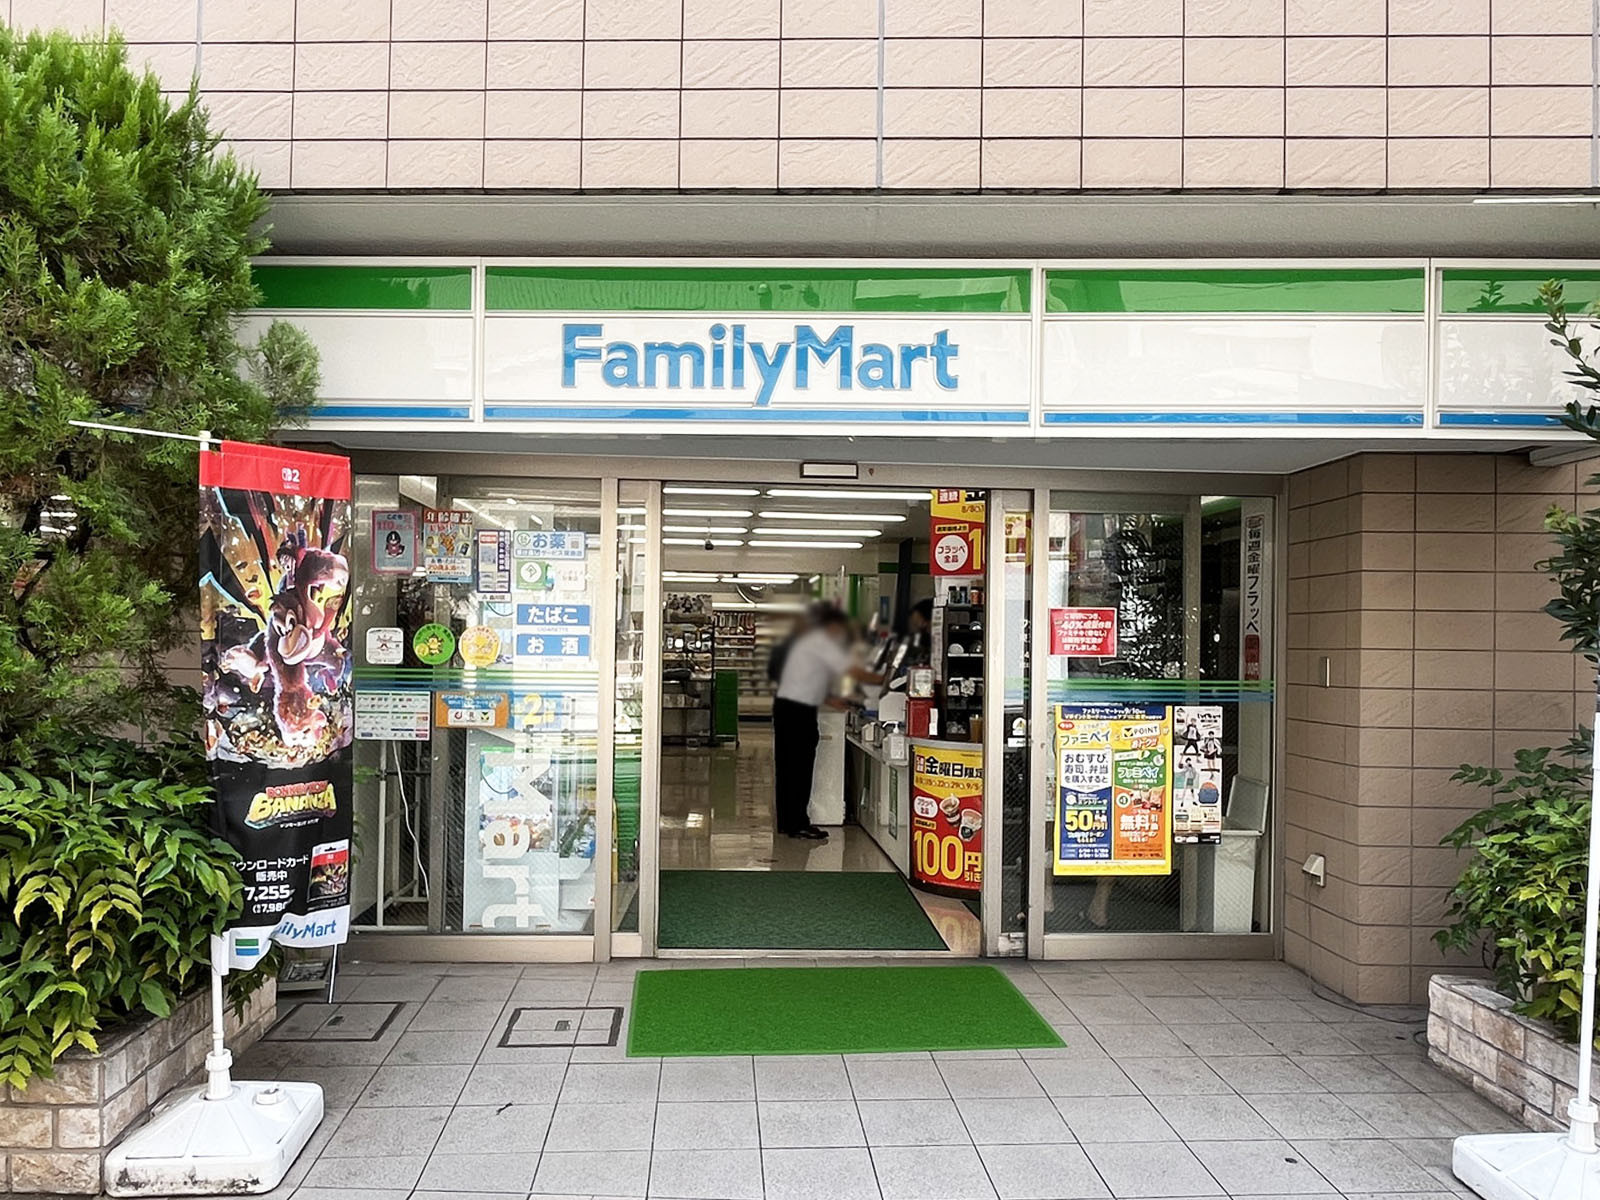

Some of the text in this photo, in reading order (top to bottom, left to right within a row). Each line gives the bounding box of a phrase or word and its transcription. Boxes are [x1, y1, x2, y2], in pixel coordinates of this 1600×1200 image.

[562, 323, 959, 408] FamilyMart
[292, 469, 300, 482] 2
[533, 533, 565, 549] お薬
[938, 545, 966, 554] フラッペ
[969, 528, 985, 570] 1
[944, 555, 959, 563] 全品
[1246, 529, 1261, 633] 毎週金曜フラッペ
[527, 606, 578, 624] たばこ
[527, 636, 579, 655] お 酒
[1060, 730, 1111, 746] ファミペイ
[1133, 726, 1158, 735] POINT
[926, 756, 983, 778] 金曜日限定
[1064, 765, 1109, 775] 寿司、弁当
[1118, 766, 1160, 779] ファミペイ
[1064, 775, 1109, 784] を購入すると
[248, 783, 337, 822] BANANZA
[1065, 811, 1094, 832] 50
[231, 855, 309, 872] ウンロードカード
[256, 870, 288, 882] 販売中
[244, 884, 295, 902] 7,255
[276, 920, 337, 939] ilyMart
